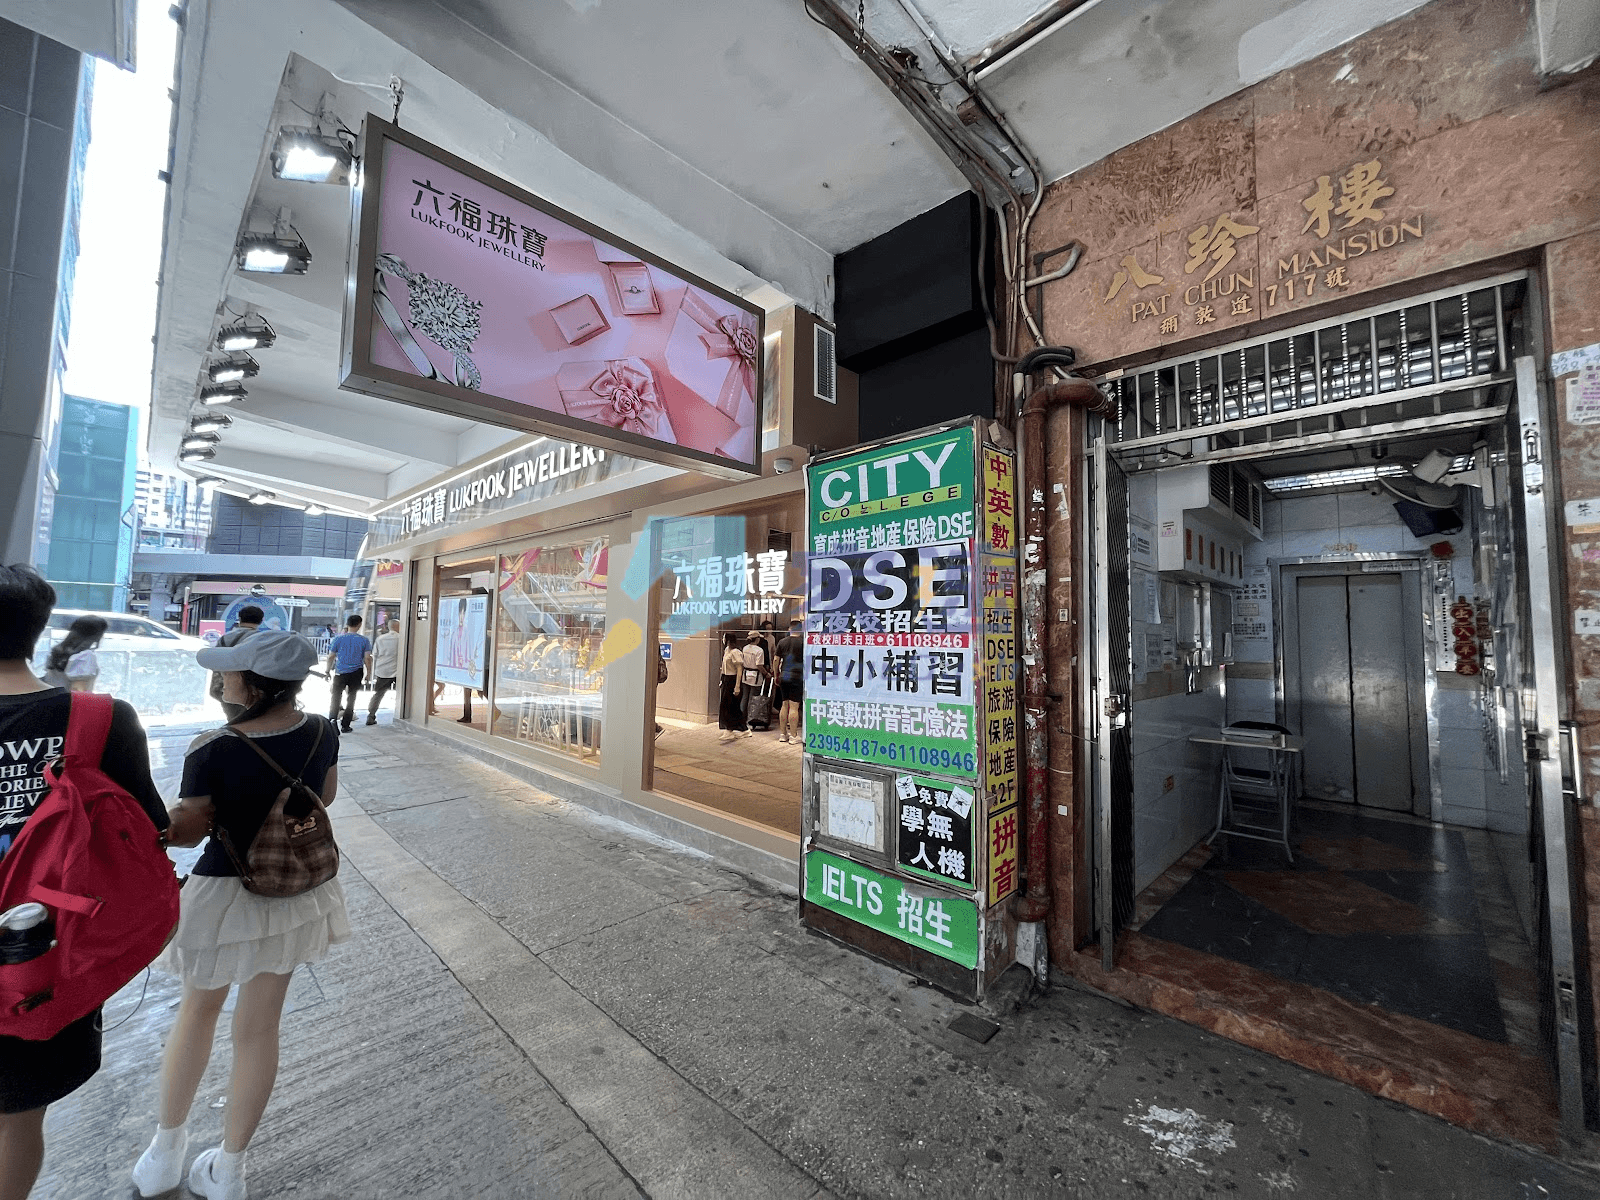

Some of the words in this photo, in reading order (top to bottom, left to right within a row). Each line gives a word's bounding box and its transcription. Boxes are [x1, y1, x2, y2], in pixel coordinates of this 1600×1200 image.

[411, 208, 475, 243] LUKFOOK
[478, 237, 546, 272] JEWELLERY
[412, 179, 548, 260] 六福珠寶
[1104, 158, 1394, 304] 八珍樓
[1131, 294, 1170, 322] PAT
[1185, 268, 1254, 307] CHUN
[1278, 214, 1424, 280] MANSION
[450, 470, 505, 513] LUKFOOK
[820, 442, 957, 509] CITY
[401, 488, 447, 535] 六福珠寶
[673, 549, 788, 600] 六福珠寶
[811, 544, 965, 611] DSE
[983, 565, 1016, 598] 拼音
[672, 602, 717, 615] LUKFOOK
[718, 599, 786, 617] JEWELLERY
[825, 608, 946, 633] 夜校招生
[983, 610, 1014, 634] 招生
[987, 639, 1014, 659] DSE
[811, 649, 963, 696] 中小補習
[986, 664, 1014, 682] IELTS
[810, 700, 968, 740] 中英數拼音記憶法
[988, 718, 1015, 745] 保險
[918, 788, 949, 809] 免費
[910, 842, 965, 879] 人機
[992, 811, 1017, 898] 拼音
[822, 864, 883, 915] IELTS
[897, 888, 953, 948] 招生
